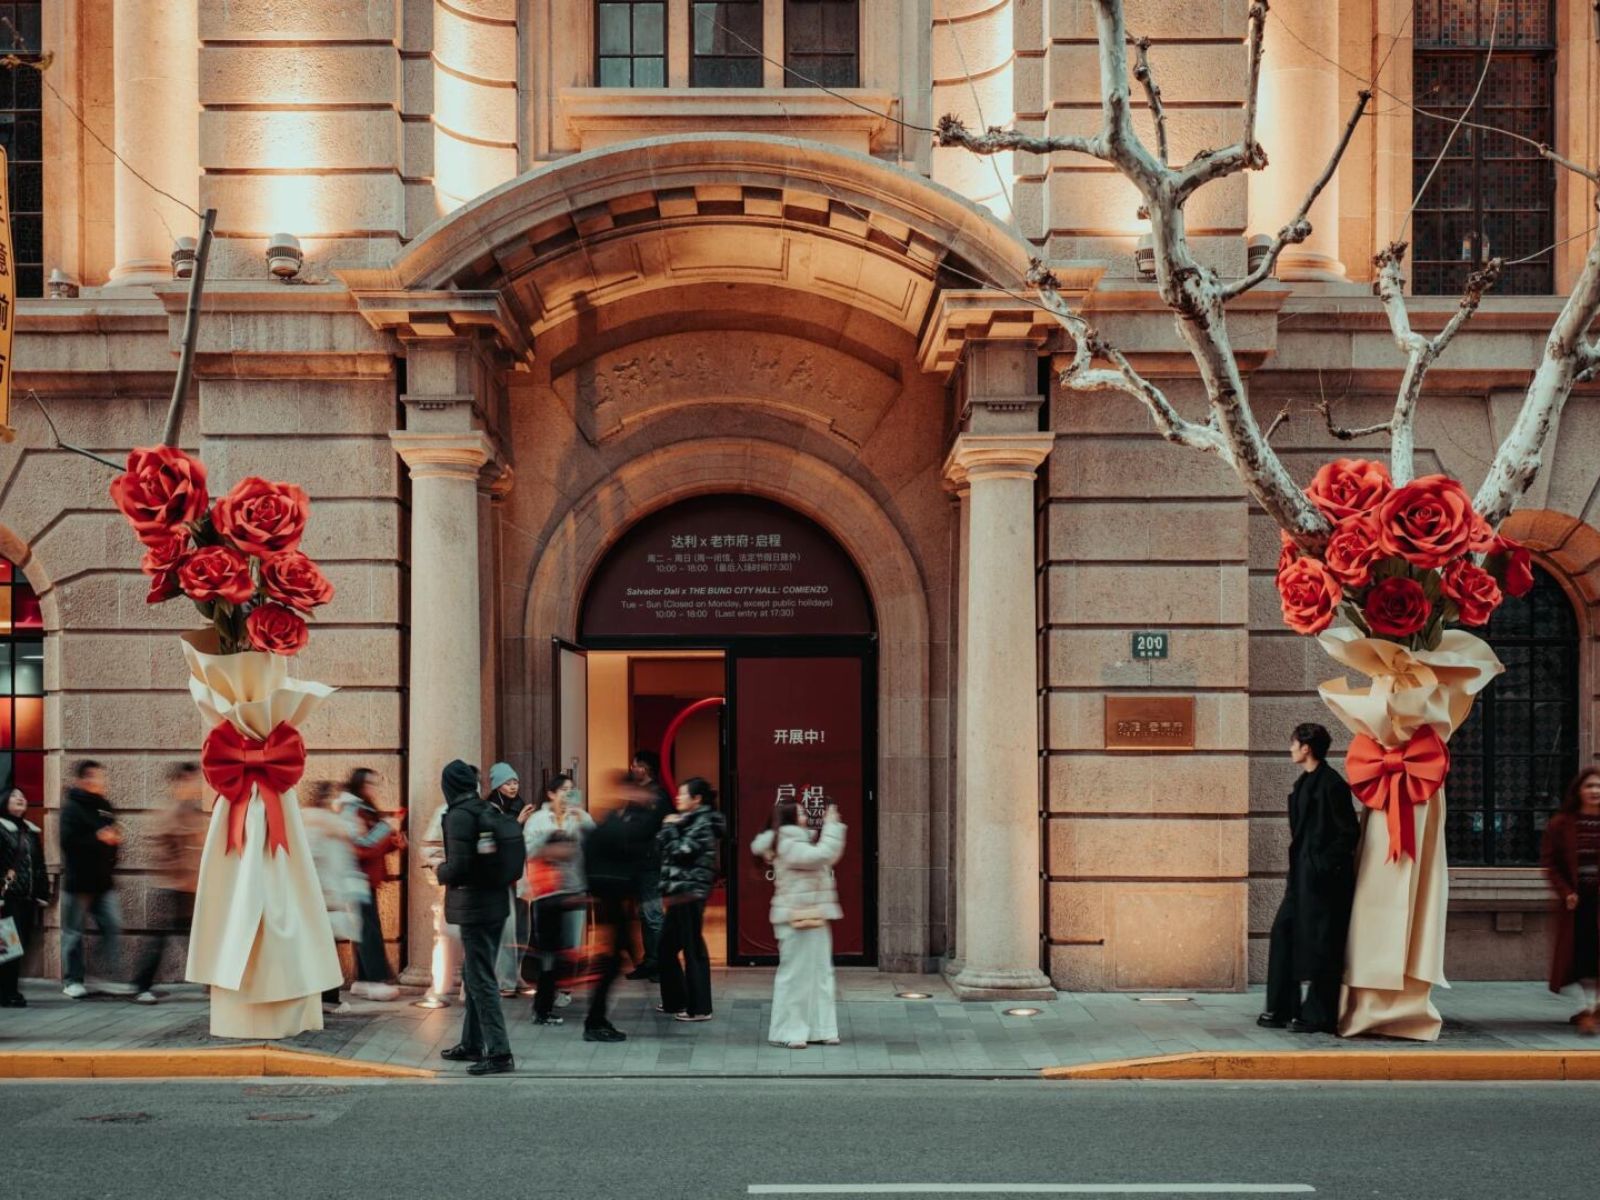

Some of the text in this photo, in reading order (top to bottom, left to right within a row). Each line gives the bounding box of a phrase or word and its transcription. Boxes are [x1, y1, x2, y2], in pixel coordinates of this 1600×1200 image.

[671, 534, 697, 548] 达利
[656, 564, 677, 573] 10:00
[626, 588, 662, 596] Salvador
[689, 587, 706, 595] THE
[707, 587, 732, 595] BUND
[733, 586, 754, 595] CITY
[782, 585, 829, 594] COMIENZO
[621, 600, 636, 609] Tue
[646, 600, 662, 609] Sun
[743, 600, 770, 609] except
[772, 599, 796, 609] public
[655, 610, 677, 618] 10:00
[686, 610, 708, 618] 18:00
[737, 610, 758, 619] entry
[760, 609, 769, 618] at
[770, 608, 795, 618] 17:30)
[1137, 636, 1163, 650] 200
